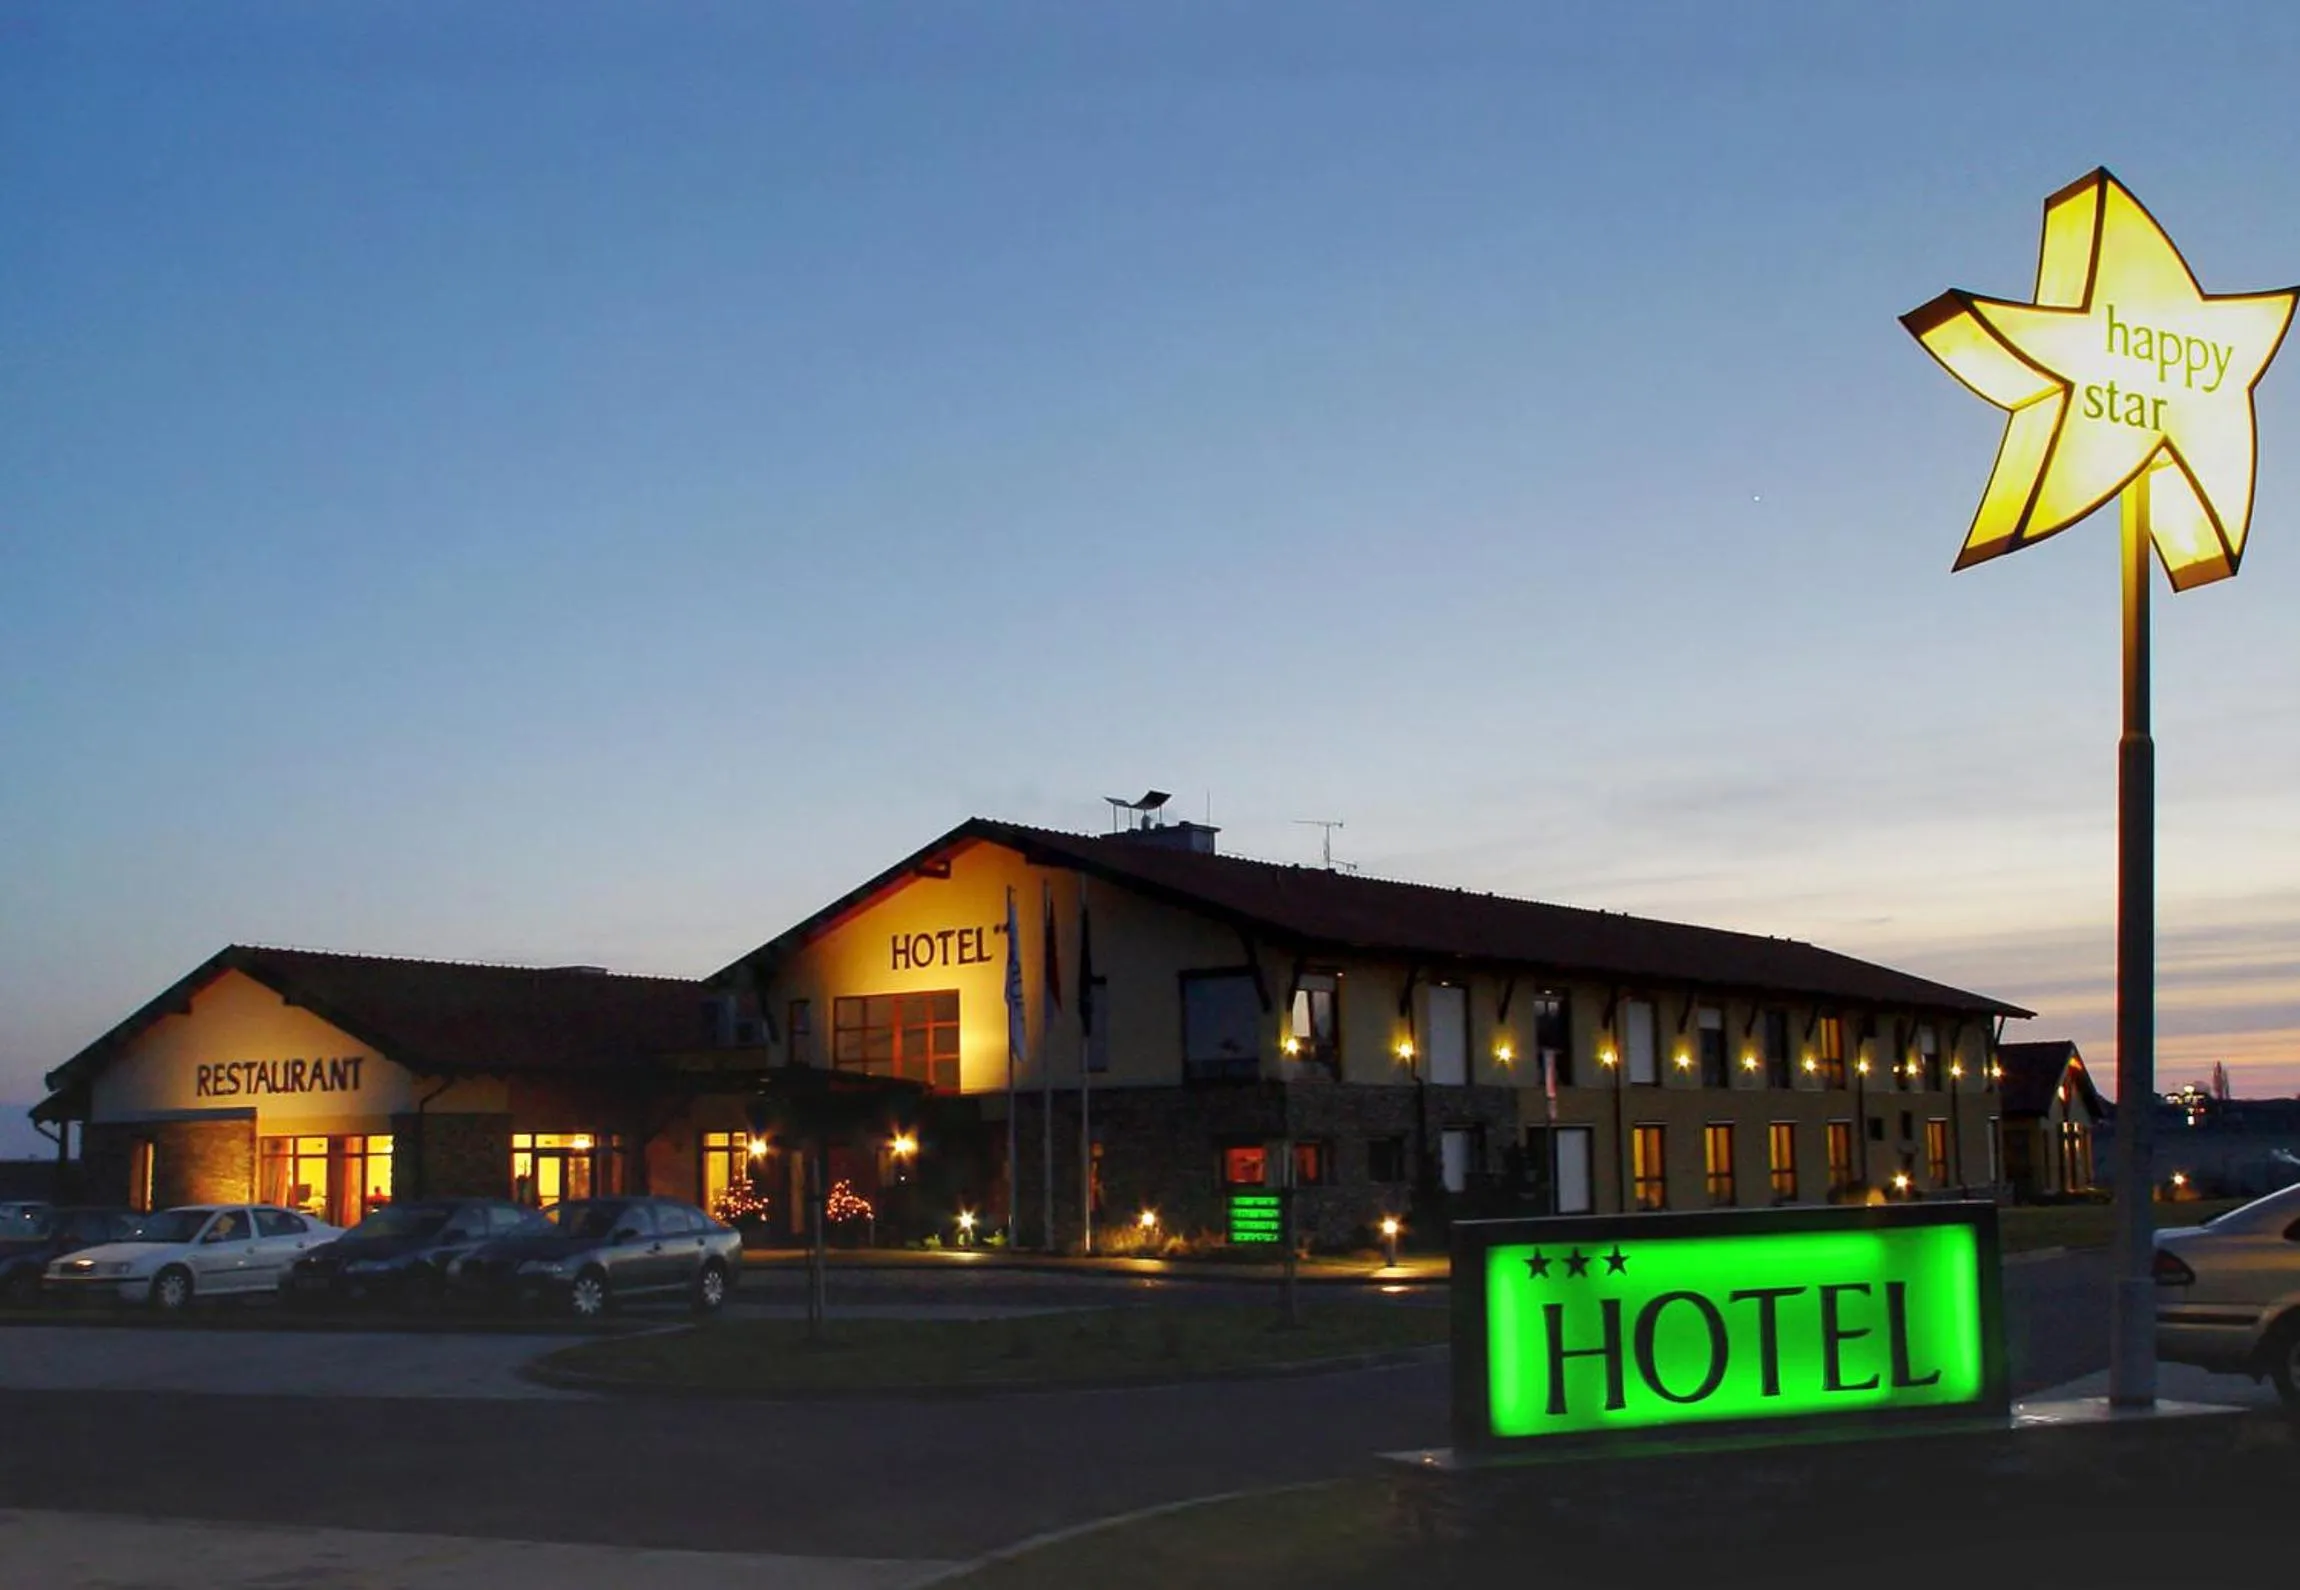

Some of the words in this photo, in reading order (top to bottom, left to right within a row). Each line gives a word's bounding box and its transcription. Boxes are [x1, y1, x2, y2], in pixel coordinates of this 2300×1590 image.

[2106, 304, 2234, 393] happy
[2083, 381, 2168, 431] star
[891, 926, 993, 970] HOTEL
[196, 1057, 364, 1097] RESTAURANT
[1541, 1281, 1942, 1415] HOTEL
